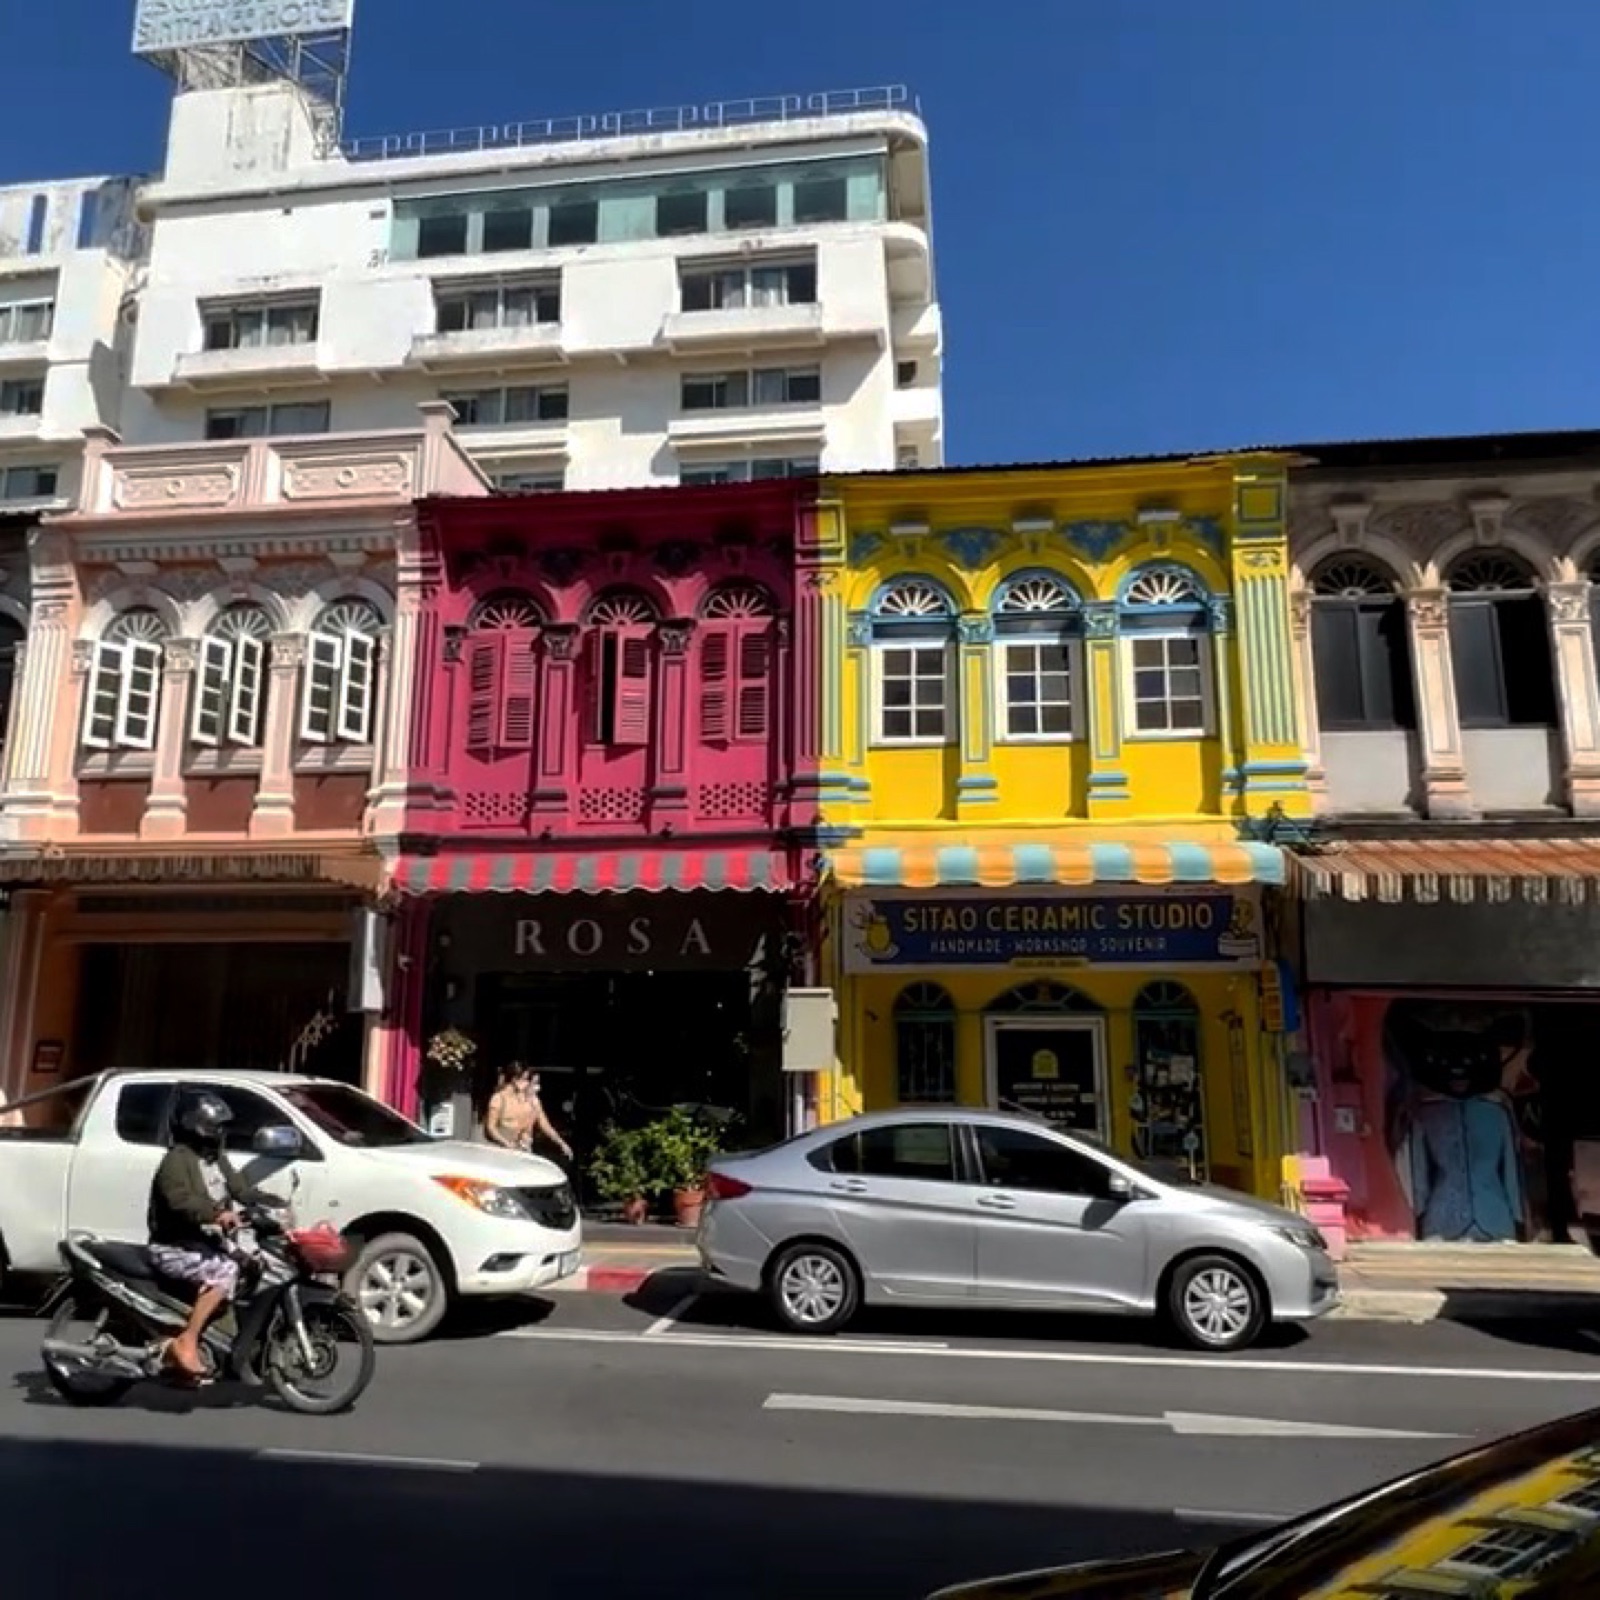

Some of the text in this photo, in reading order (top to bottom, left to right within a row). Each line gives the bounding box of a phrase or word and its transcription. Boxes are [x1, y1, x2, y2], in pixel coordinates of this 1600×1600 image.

[903, 903, 1214, 933] SITAO CERAMIC STUDIO
[514, 917, 712, 955] ROSA
[930, 936, 1168, 954] HANDMADE WORKSHOP SOUVENIR
